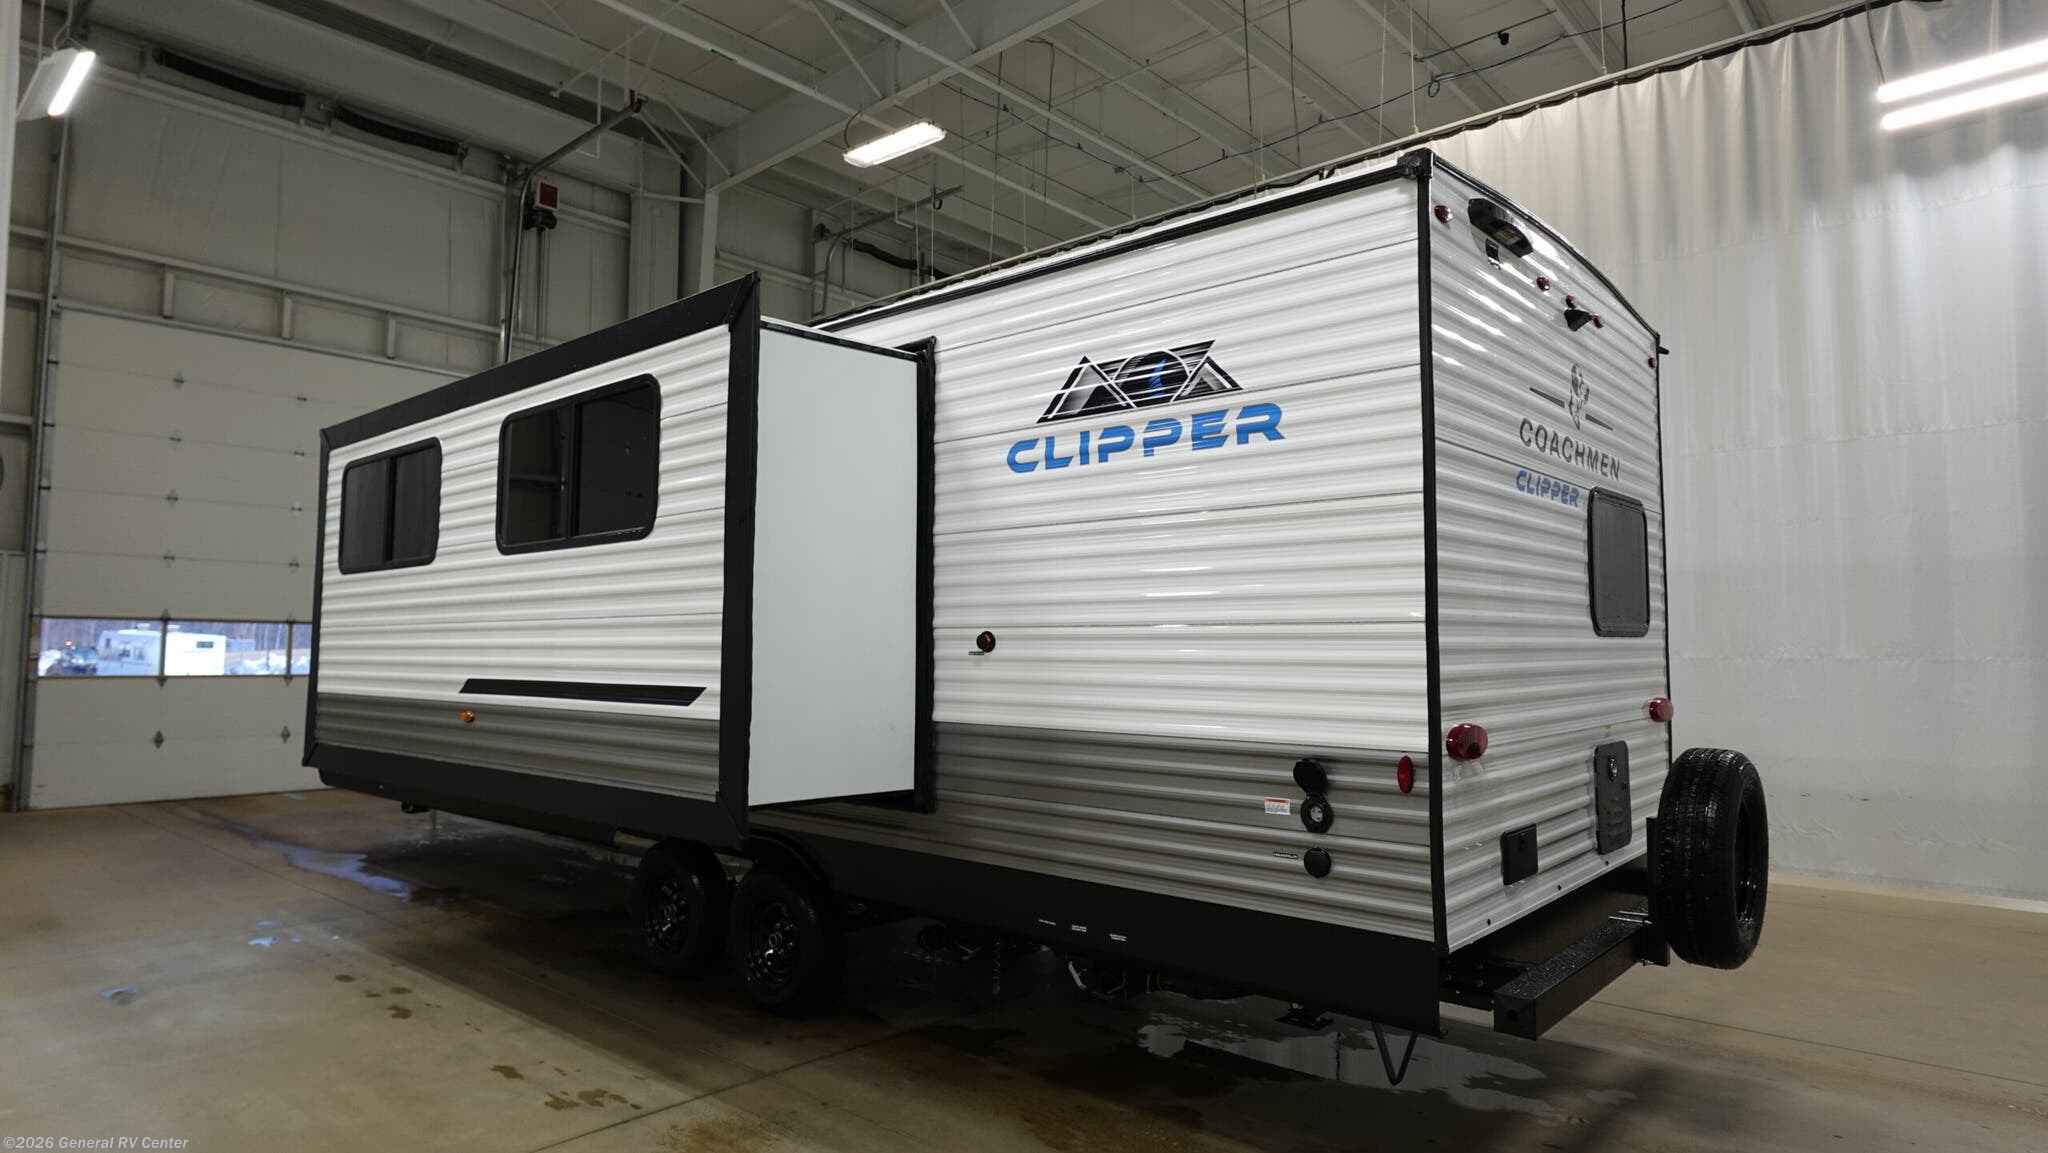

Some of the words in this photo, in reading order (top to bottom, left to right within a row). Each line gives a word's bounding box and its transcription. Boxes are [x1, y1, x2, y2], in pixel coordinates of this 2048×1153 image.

[1006, 402, 1286, 474] CLIPPER
[1519, 418, 1621, 481] COACHMEN
[1516, 470, 1580, 507] CLIPPER
